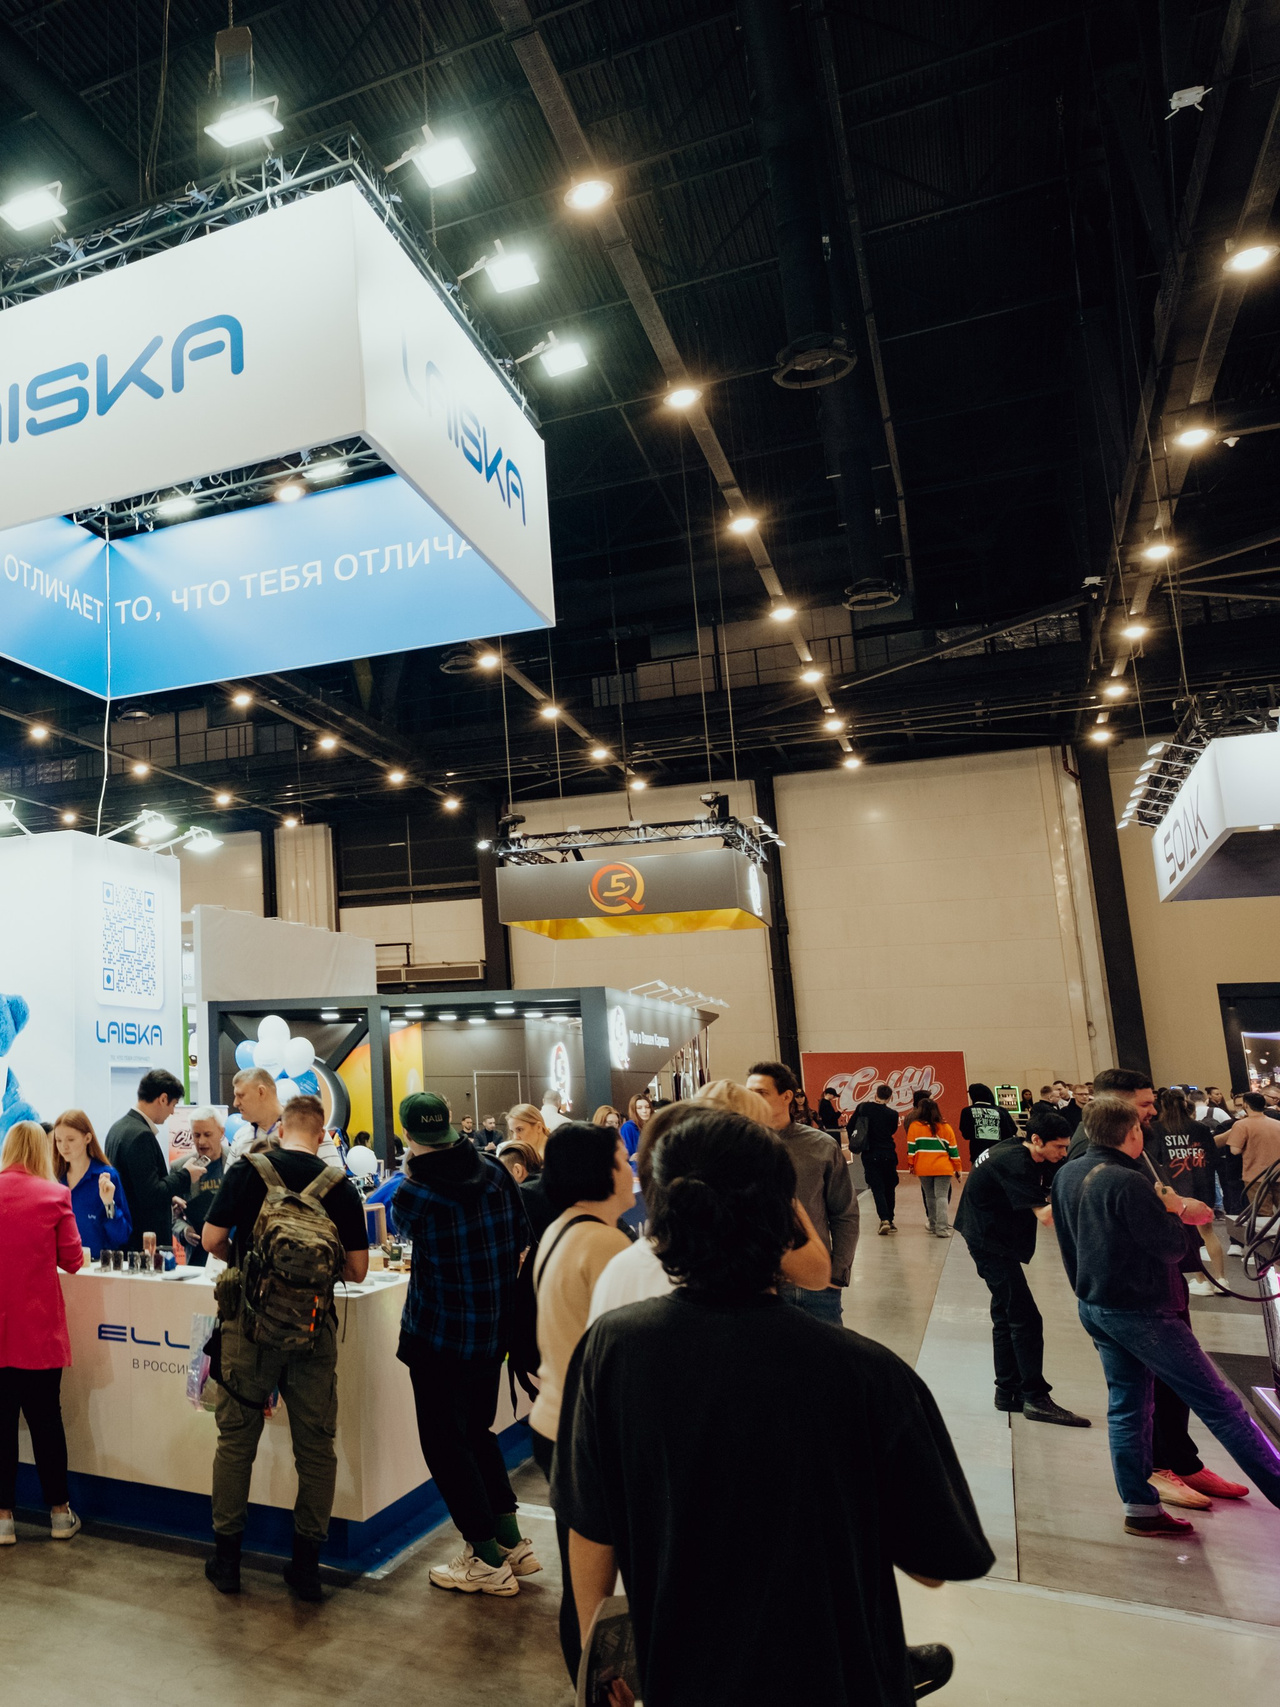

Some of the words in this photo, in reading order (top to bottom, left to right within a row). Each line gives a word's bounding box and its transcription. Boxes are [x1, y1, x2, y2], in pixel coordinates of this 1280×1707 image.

[402, 327, 526, 527] LAISKA
[4, 553, 104, 624] ОТЛИЧАЕТ
[115, 596, 161, 625] ТО,
[171, 579, 231, 612] ЧТО
[239, 559, 322, 600] ТЕБЯ
[96, 1020, 163, 1046] LAISKA
[1164, 1134, 1190, 1147] STAY
